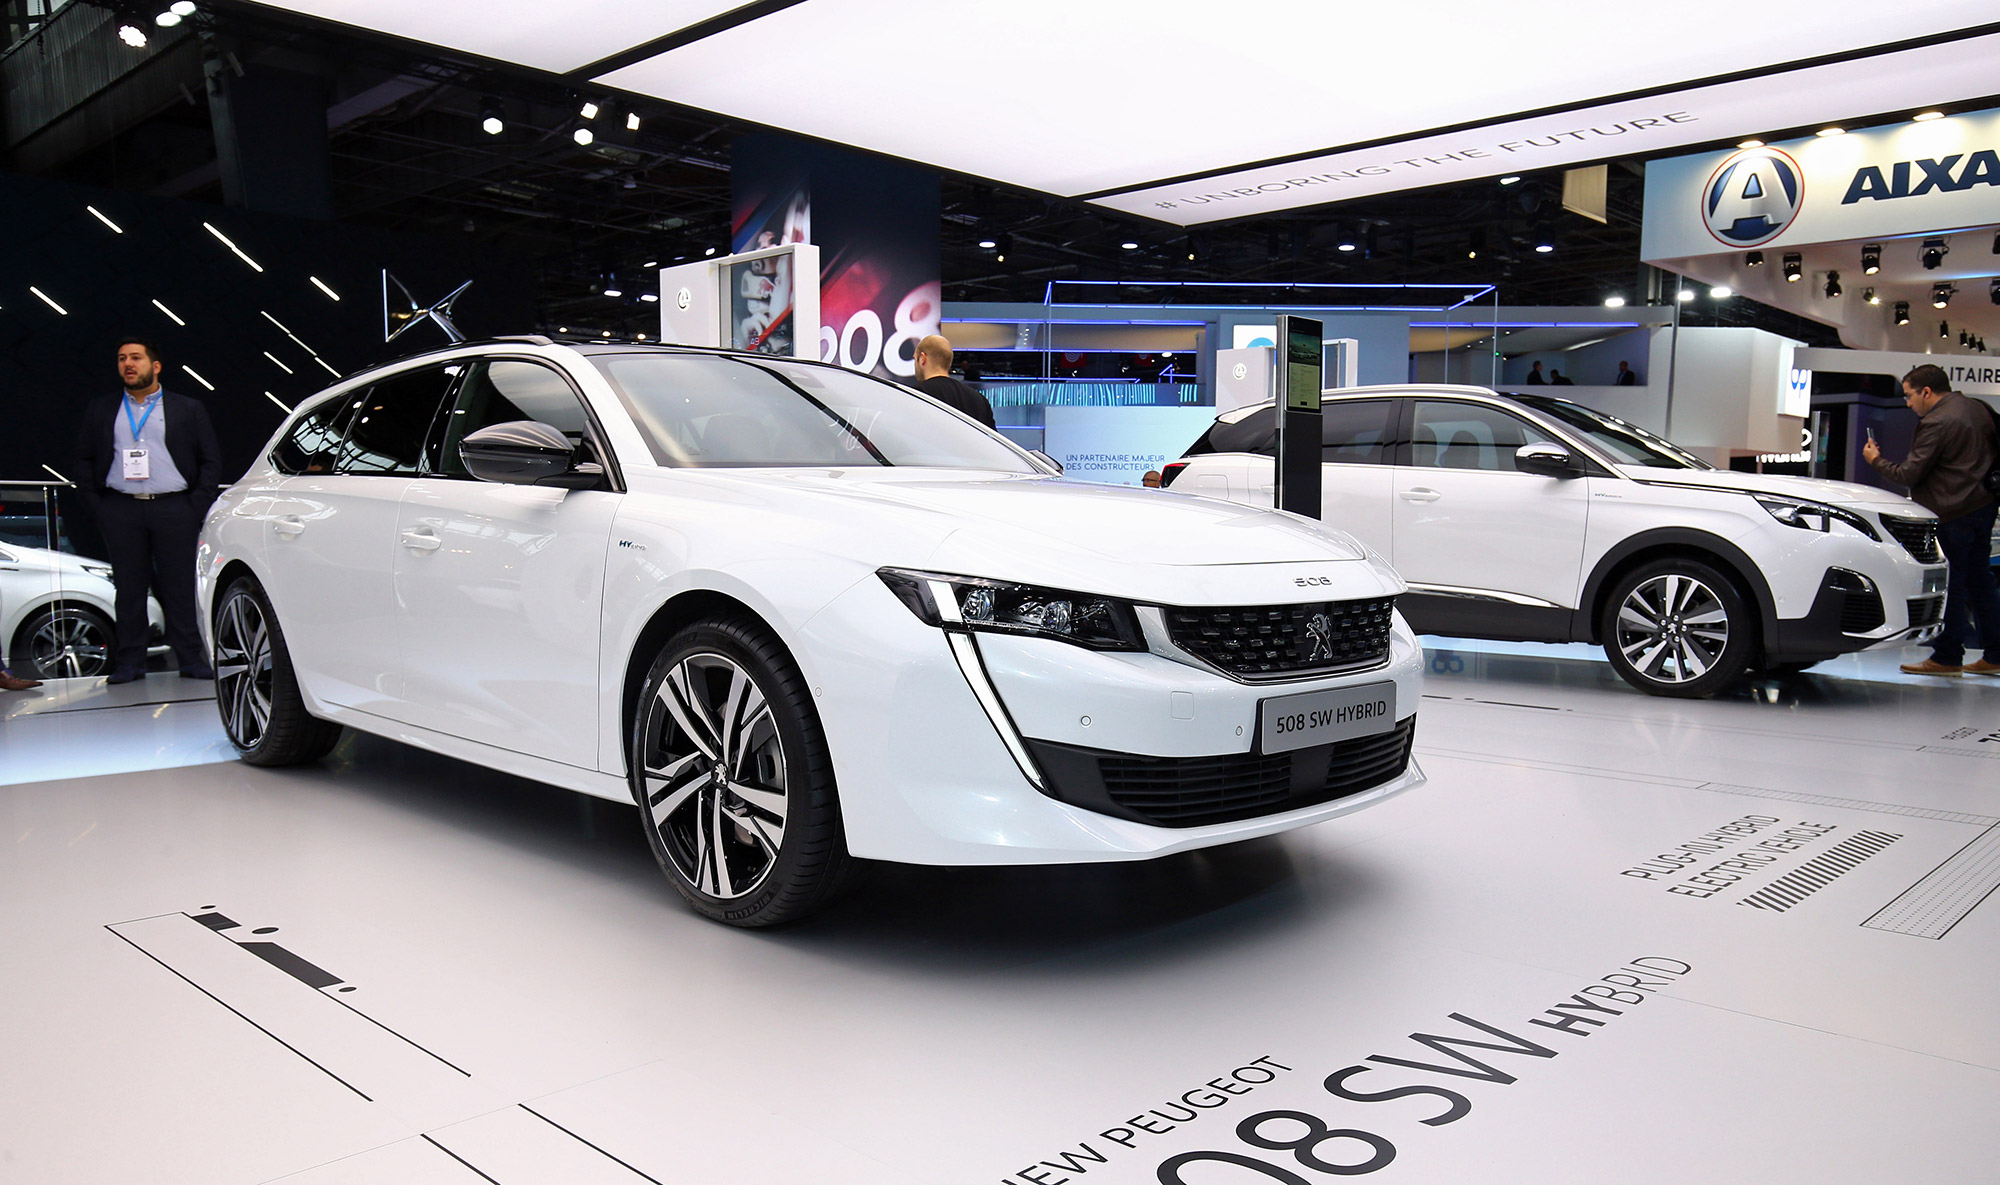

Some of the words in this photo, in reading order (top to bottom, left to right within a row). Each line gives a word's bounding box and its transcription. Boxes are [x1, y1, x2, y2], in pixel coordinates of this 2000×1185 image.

[1179, 165, 1391, 205] UNBORING
[1393, 148, 1492, 168] THE
[1498, 110, 1699, 152] FUTURE
[1841, 149, 2000, 205] AIXA
[1066, 454, 1078, 462] UN
[1081, 454, 1129, 462] PARTENAIRE
[1132, 454, 1166, 462] MAJEUR
[1066, 462, 1082, 471] DES
[1084, 462, 1155, 471] CONSTRUCTEURS
[1292, 576, 1333, 587] 508
[1276, 713, 1305, 734] 508
[1310, 708, 1333, 729] SW
[1336, 700, 1387, 724] HYBRID
[1619, 840, 1724, 881] PLUG-IN
[1698, 814, 1780, 844] HYBRID
[1666, 853, 1778, 899] ELECTRIC
[1748, 821, 1837, 854] VEHICLE
[1323, 1011, 1559, 1127] SW
[1528, 956, 1692, 1037] HYBRID
[1001, 1142, 1109, 1185] EW
[1099, 1055, 1292, 1149] PEUGEOT
